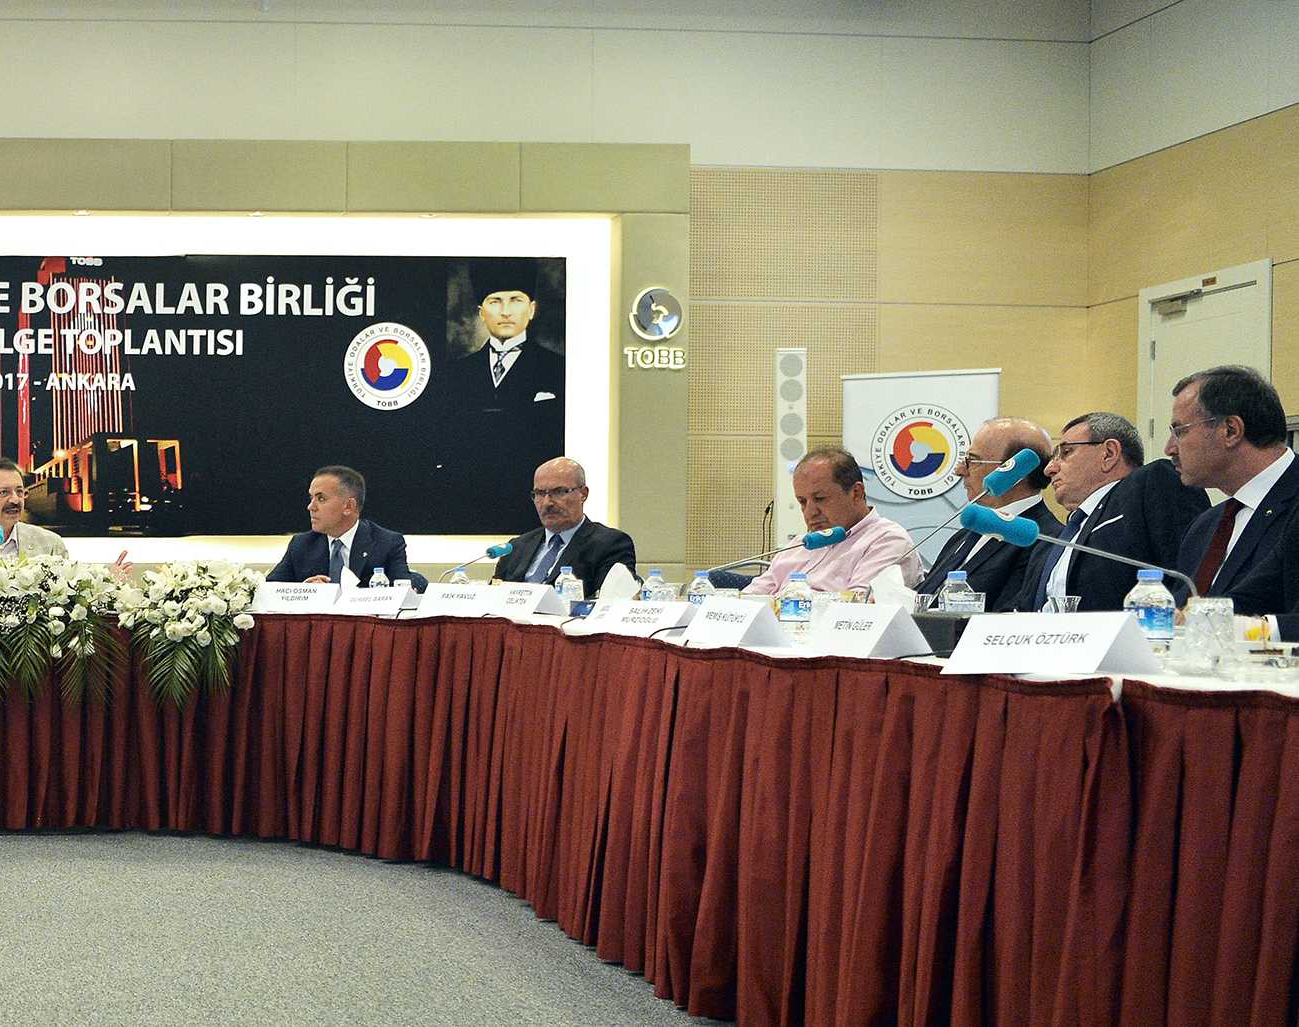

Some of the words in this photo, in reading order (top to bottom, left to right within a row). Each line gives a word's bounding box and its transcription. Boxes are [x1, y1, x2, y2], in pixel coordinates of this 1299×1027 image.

[70, 257, 103, 266] TOBB
[21, 282, 230, 315] BORSALAR
[239, 275, 375, 317] BİRLİĞİ
[60, 328, 244, 356] TOPLANTISI
[624, 346, 686, 369] TOBB
[45, 372, 136, 391] ANKARA
[877, 412, 907, 443] ODALAR
[910, 407, 923, 415] VE
[927, 408, 966, 447] BORSALAR
[908, 488, 934, 496] TOBB
[983, 634, 1033, 646] SELÇUK
